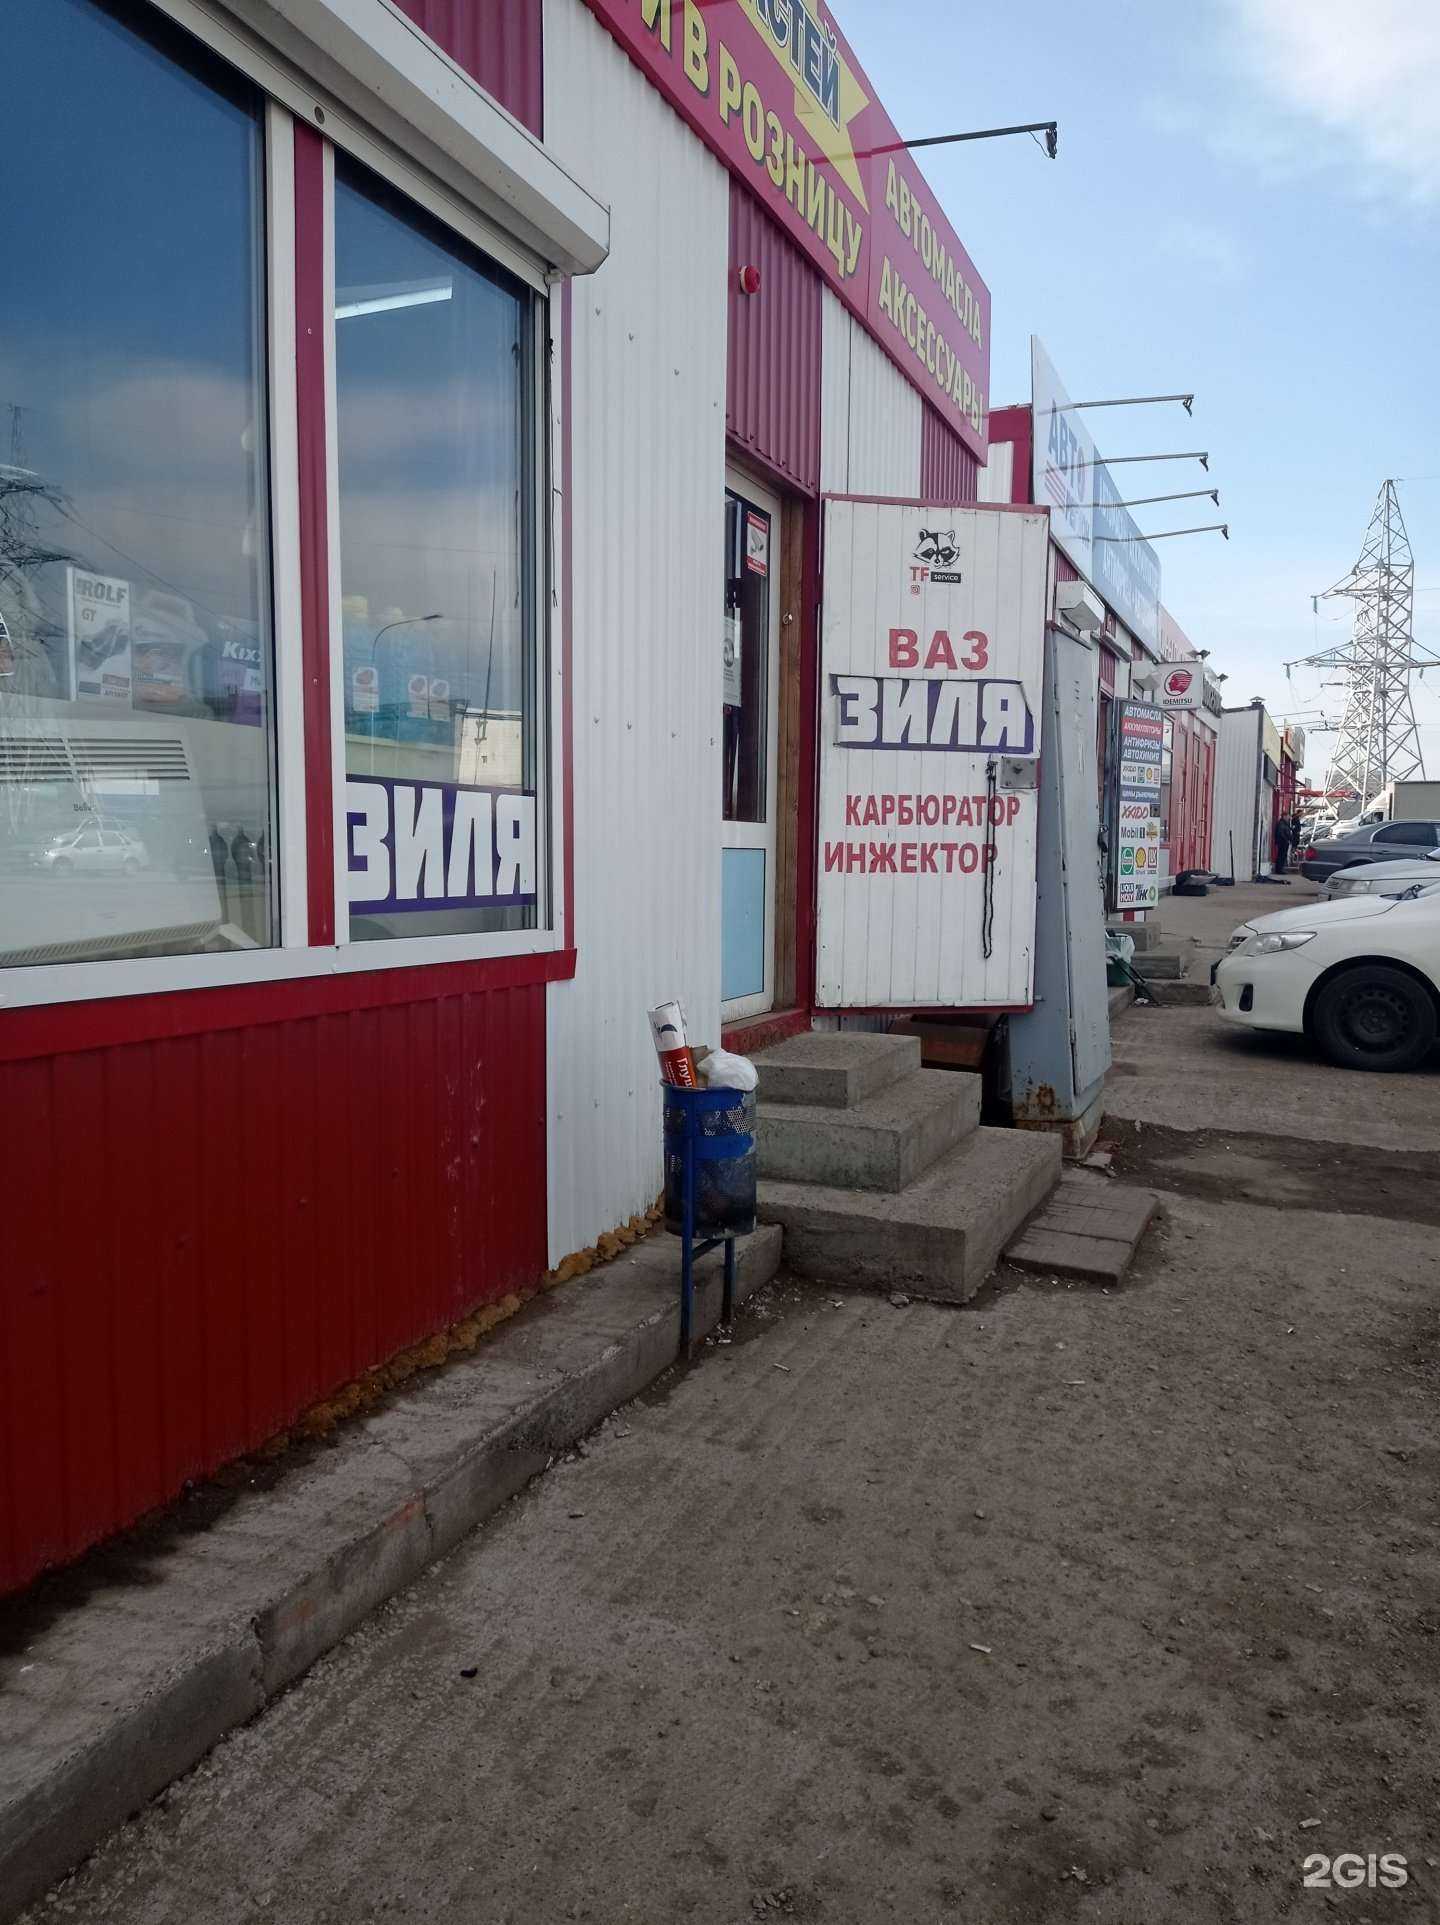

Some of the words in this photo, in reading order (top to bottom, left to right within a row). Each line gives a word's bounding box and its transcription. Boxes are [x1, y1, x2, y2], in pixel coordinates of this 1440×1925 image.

[683, 0, 709, 94] В
[719, 40, 862, 280] РОЗНИЦУ
[885, 157, 983, 349] АВТОМАСЛА
[878, 255, 984, 436] АКСЕССУАРЫ
[909, 566, 930, 582] TF
[77, 580, 127, 604] ROLF
[82, 607, 95, 622] GT
[888, 628, 989, 671] ВАЗ
[834, 675, 1028, 749] ЗИЛЯ
[1124, 706, 1162, 721] АВТОМАСЛА
[1122, 735, 1161, 750] АНТИФРИЗЫ
[1122, 748, 1160, 761] АВТОХИМИЯ
[845, 794, 1021, 827] КАРБЮРАТОР
[346, 781, 536, 903] ЗИЛЯ
[1120, 826, 1138, 839] Mobil
[824, 841, 999, 874] ИНЖЕКТОР
